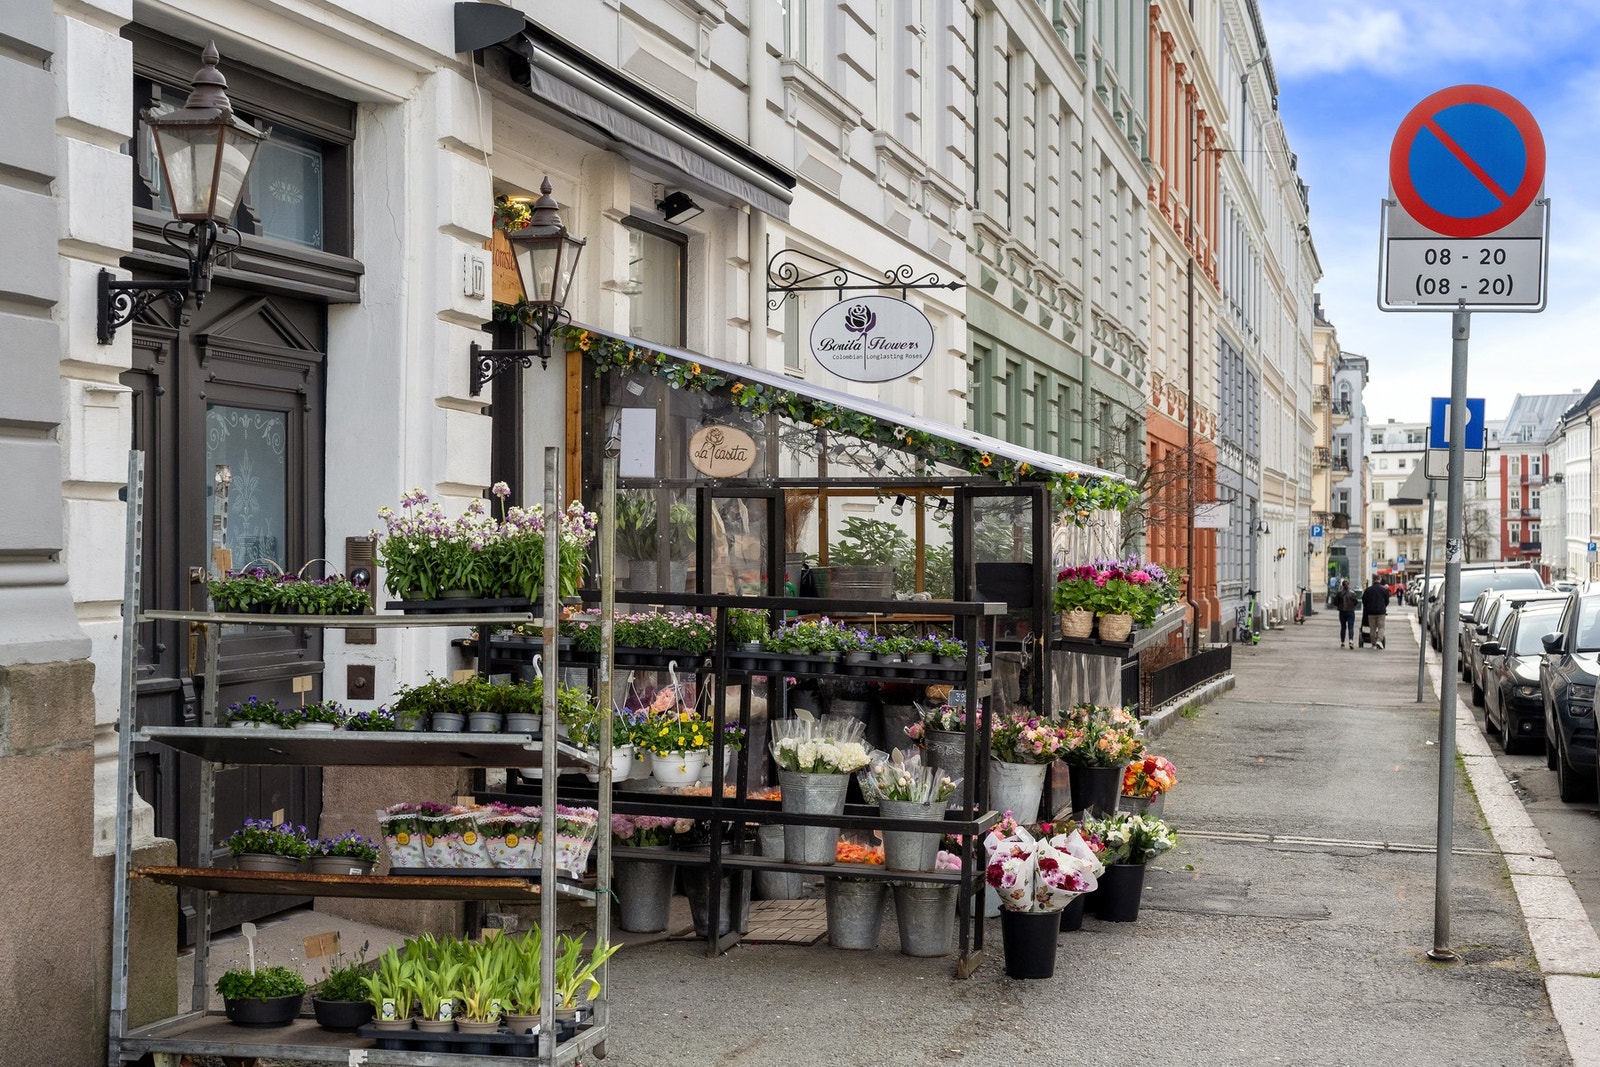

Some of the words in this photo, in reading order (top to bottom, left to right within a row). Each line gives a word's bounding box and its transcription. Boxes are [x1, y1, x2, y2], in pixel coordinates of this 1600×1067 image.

[1424, 248, 1451, 265] 08
[1479, 248, 1506, 265] 20
[475, 265, 482, 291] 17
[1416, 274, 1450, 296] (08
[1478, 274, 1513, 296] 20)
[817, 337, 862, 352] Bonita
[868, 336, 919, 350] Flowers
[1313, 526, 1320, 536] P
